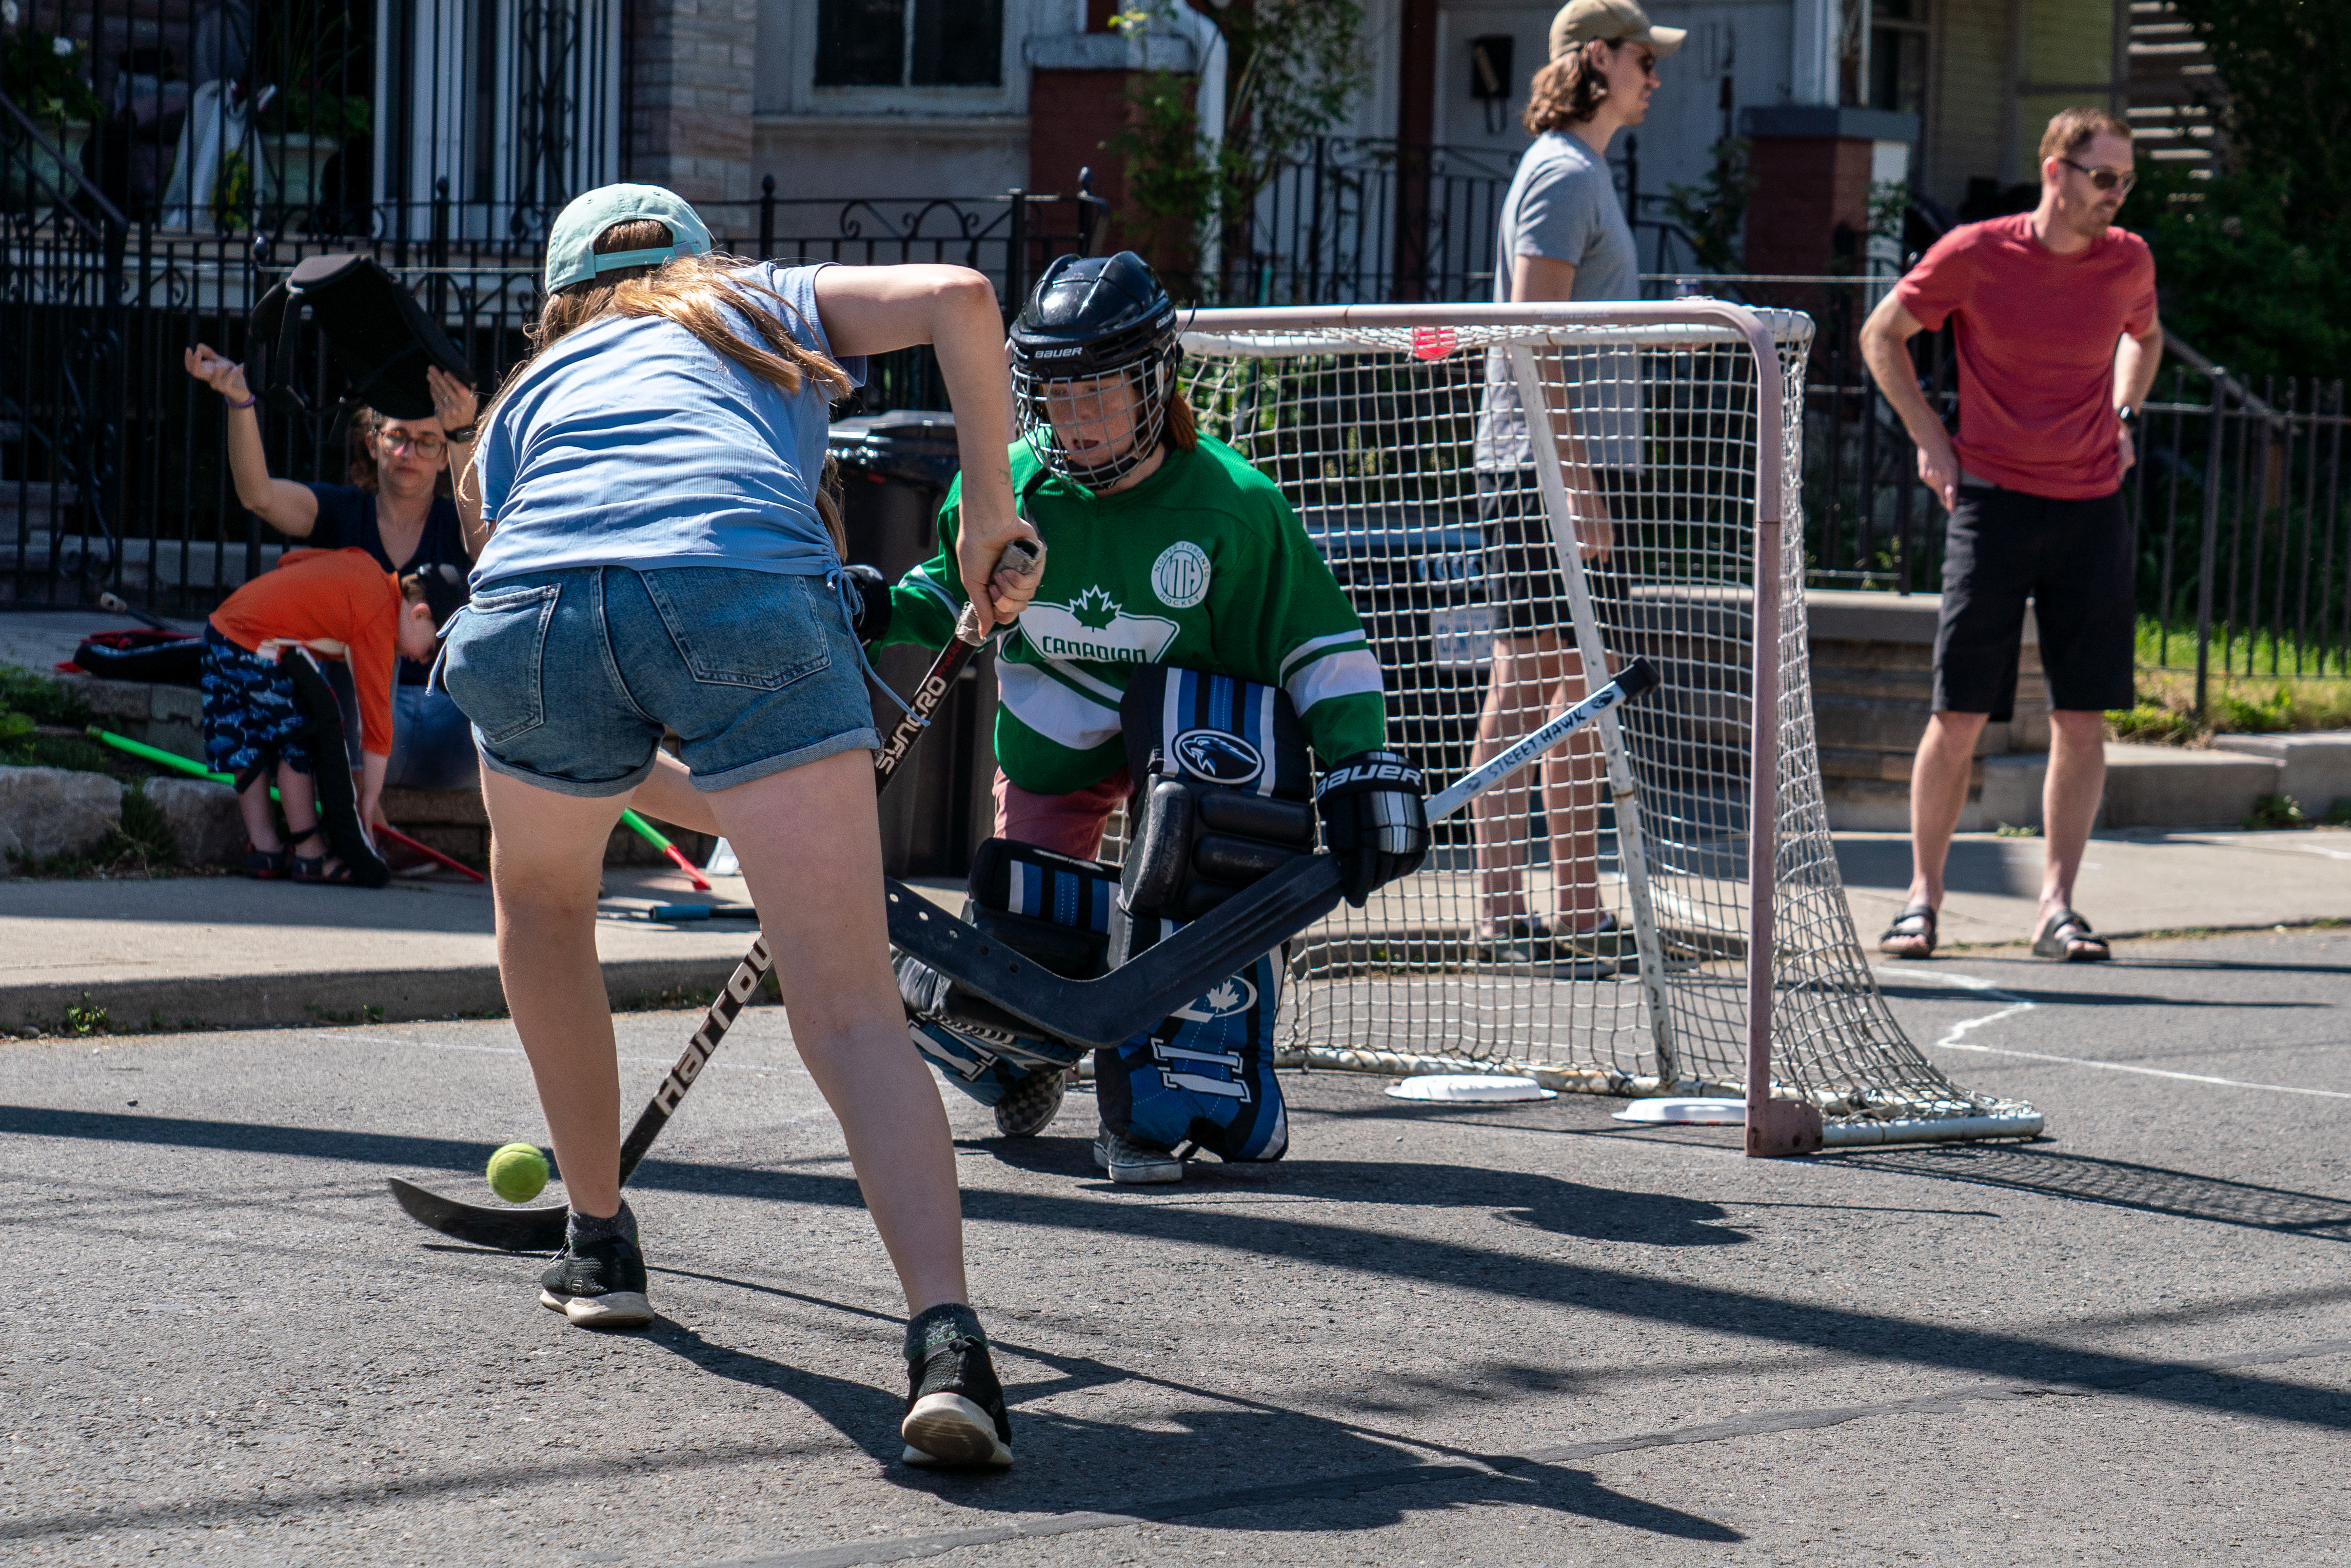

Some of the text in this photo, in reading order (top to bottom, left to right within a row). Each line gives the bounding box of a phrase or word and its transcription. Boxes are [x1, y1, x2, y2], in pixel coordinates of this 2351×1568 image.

[1034, 347, 1083, 359] BAUER
[1154, 543, 1209, 578] NORTH TORONTO
[1160, 592, 1199, 606] HOCKEY
[1042, 635, 1147, 663] CANADIAN
[1487, 708, 1586, 777] STREET HAWK
[1316, 764, 1422, 801] BAUER
